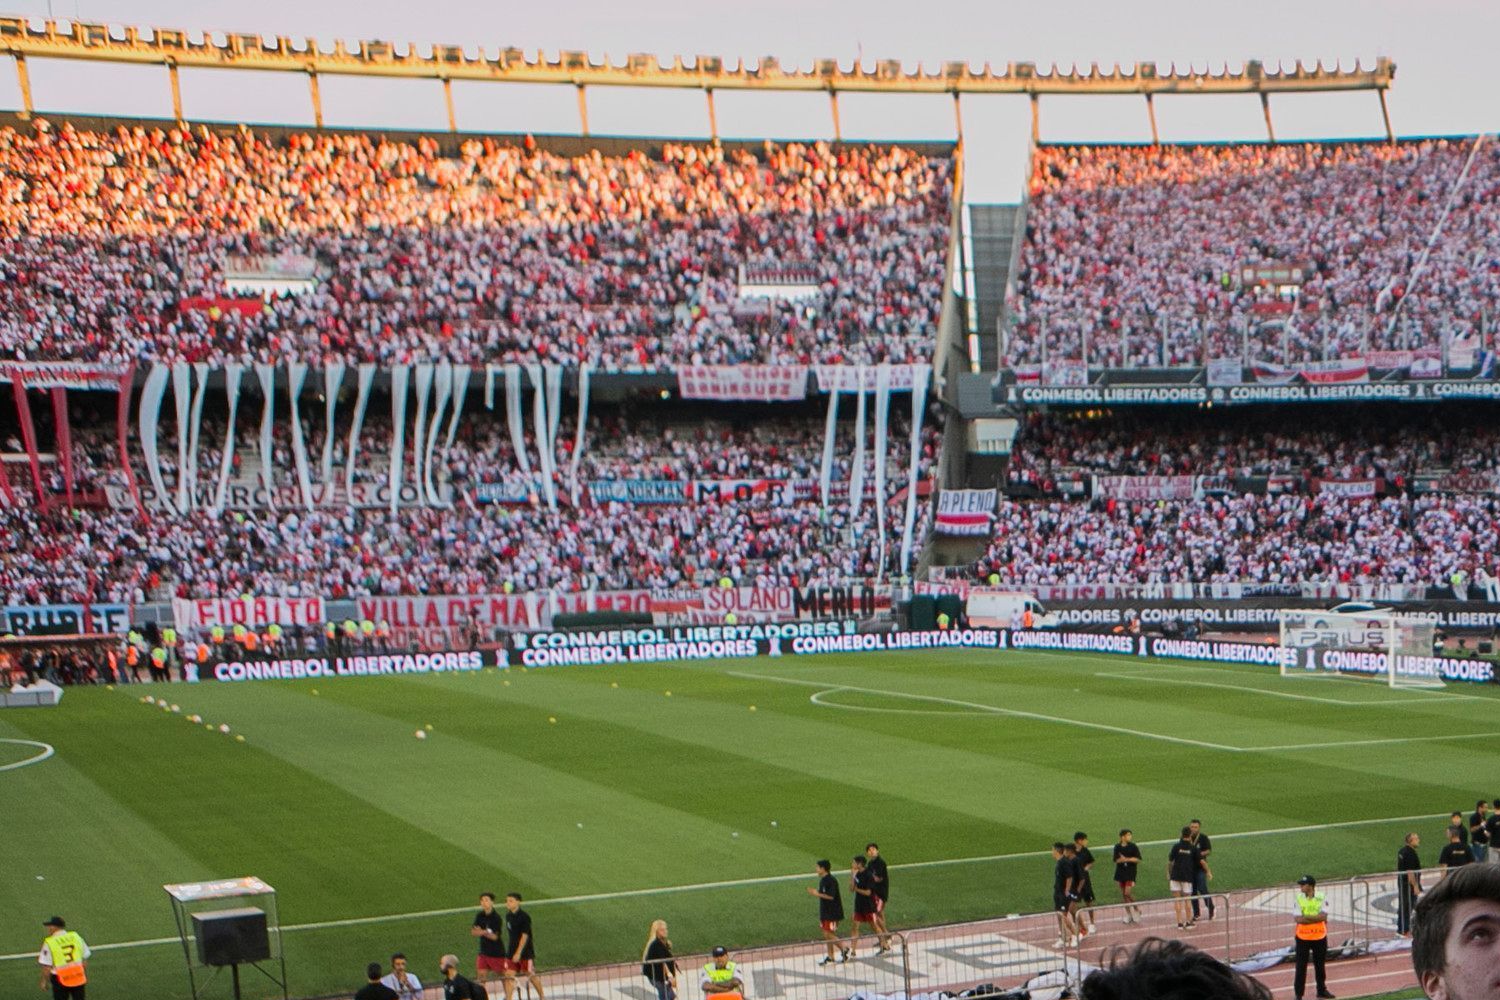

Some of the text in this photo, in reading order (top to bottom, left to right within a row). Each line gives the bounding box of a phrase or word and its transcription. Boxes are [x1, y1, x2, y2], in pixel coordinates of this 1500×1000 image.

[1022, 387, 1206, 401] CONMEBOL LIBERTADORES
[1230, 384, 1411, 399] CONMEBOL LIBERTADORES
[709, 586, 792, 611] SOLANO
[198, 598, 322, 627] FIORITO
[360, 597, 441, 628] VILLA
[1140, 608, 1223, 623] CONMEBOL
[674, 621, 841, 642] LIBERTADORES
[792, 629, 998, 655] CONMEBOL LIBERTADORES
[1011, 631, 1134, 653] CONMEBOL LIBERTADORES
[1300, 630, 1385, 646] PRIUS
[522, 639, 758, 667] CONMEBOL LIBERTADORES
[1152, 638, 1299, 668] CONMEBOL LIBERTADORES
[214, 651, 484, 682] CONMEBOL LIBERTADORES
[1397, 655, 1495, 682] LIBERTADORES
